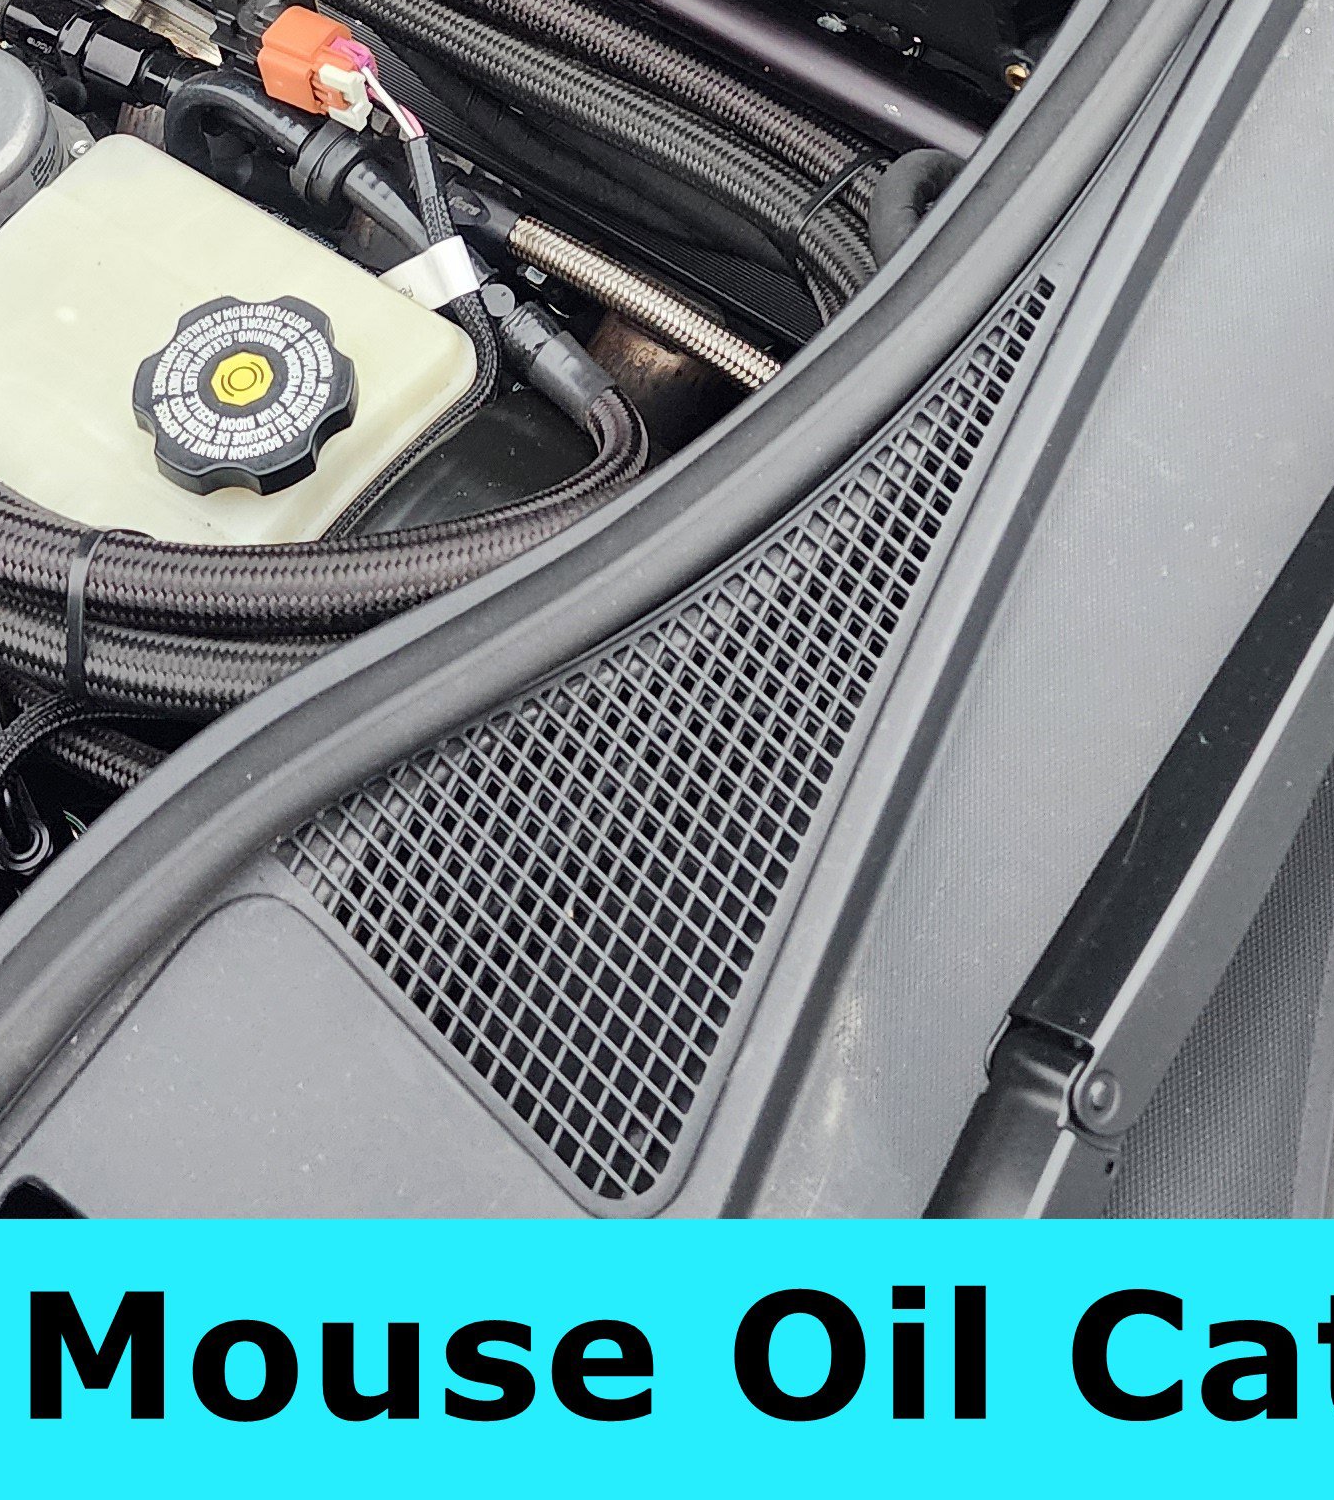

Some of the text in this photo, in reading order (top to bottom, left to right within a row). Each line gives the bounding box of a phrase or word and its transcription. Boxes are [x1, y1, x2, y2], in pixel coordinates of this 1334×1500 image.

[222, 304, 254, 320] FROM
[255, 304, 287, 321] FLUID
[176, 314, 214, 346] SEALED
[197, 333, 233, 361] CLEAN
[218, 414, 256, 431] BIDON
[213, 430, 231, 445] DE
[231, 422, 278, 446] LIQUIDE
[280, 425, 299, 443] LE
[190, 440, 228, 460] AVANT
[227, 434, 284, 460] BOUCHON
